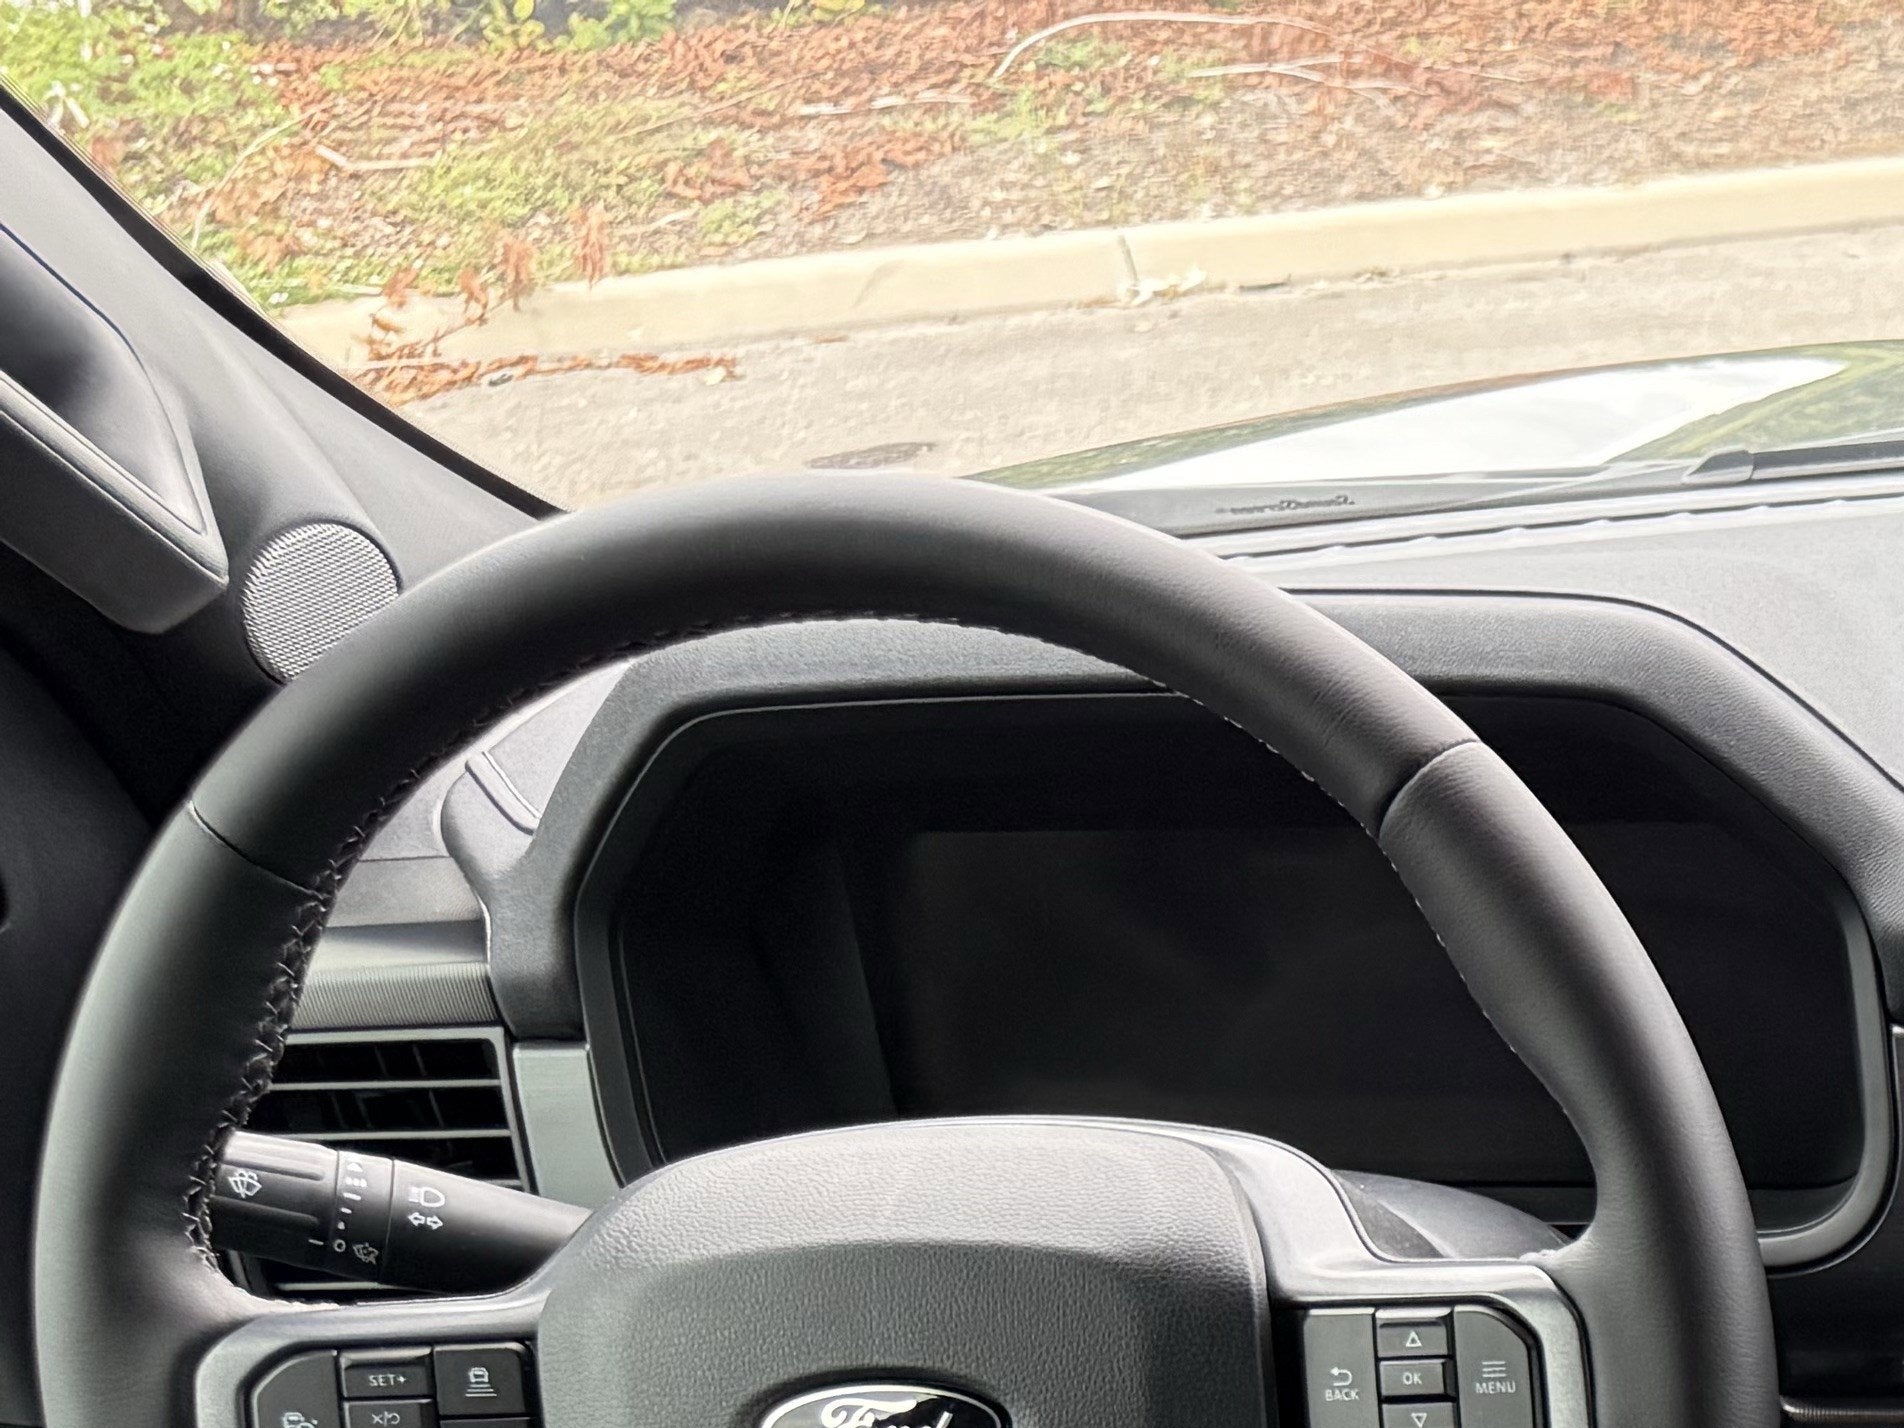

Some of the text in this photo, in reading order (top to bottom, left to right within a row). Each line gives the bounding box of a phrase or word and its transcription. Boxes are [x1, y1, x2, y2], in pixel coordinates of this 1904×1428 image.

[1402, 1372, 1423, 1385] OK
[1475, 1381, 1516, 1394] MENU
[1324, 1389, 1360, 1401] BACK
